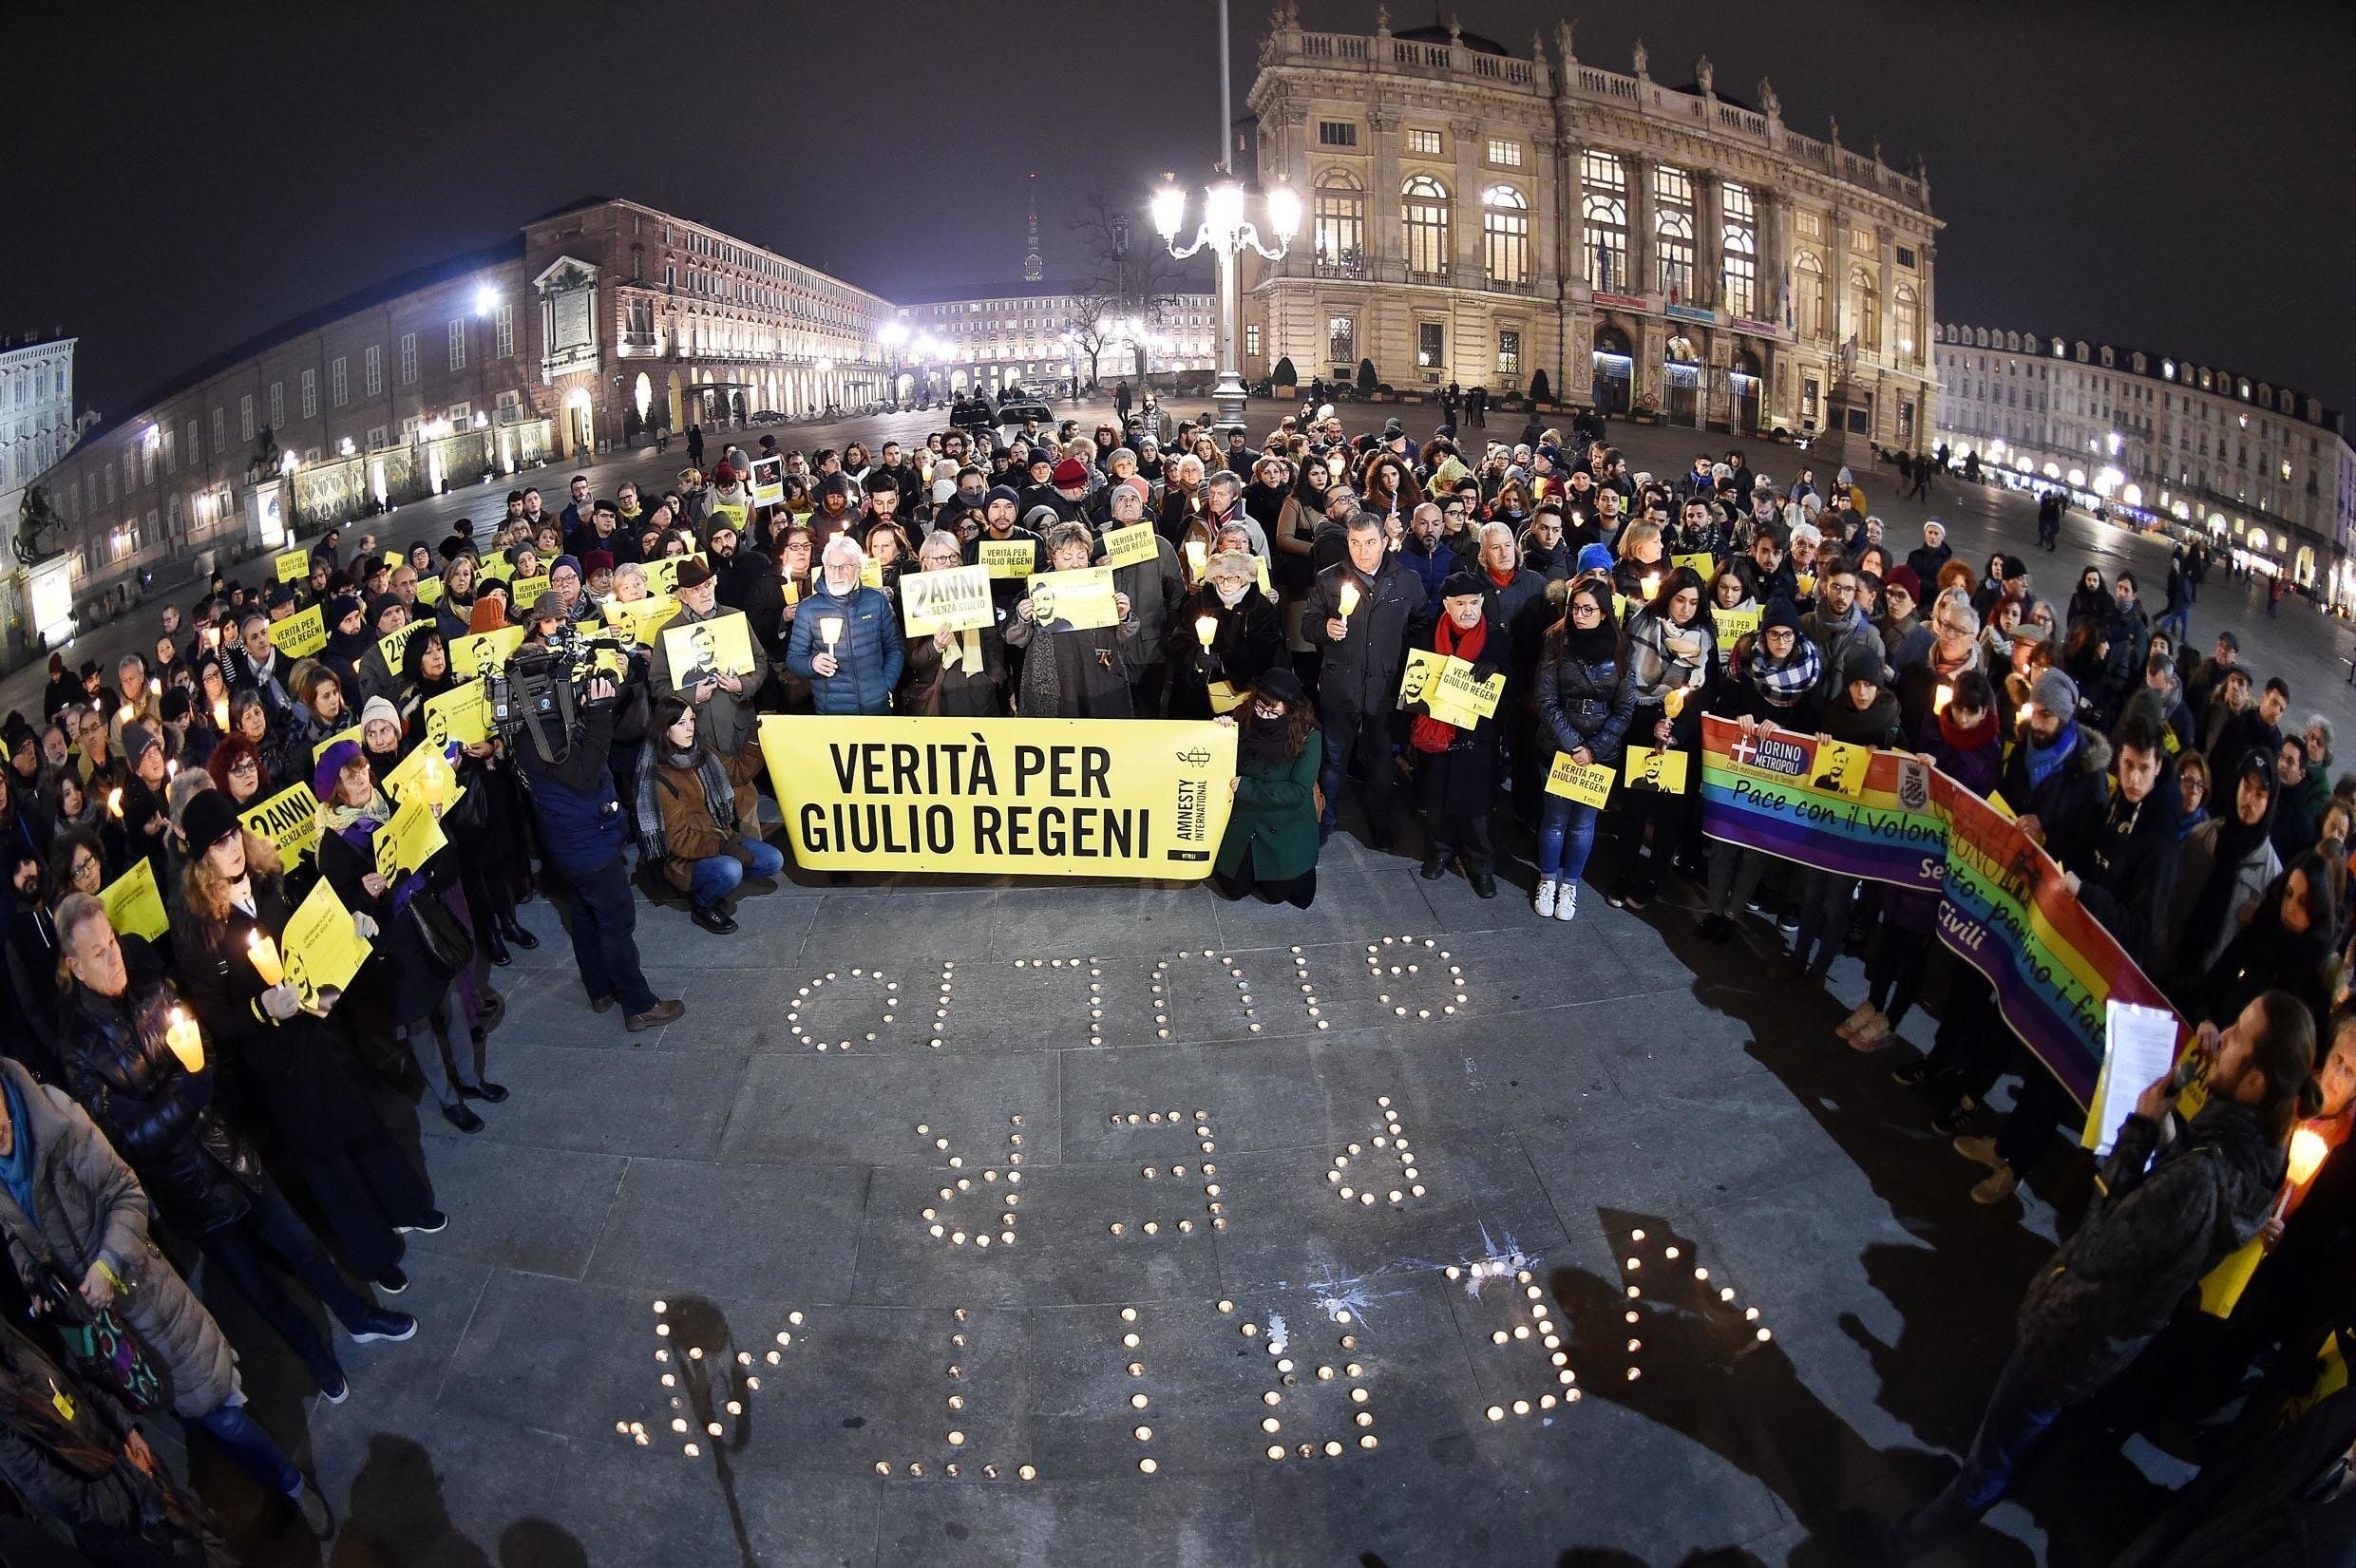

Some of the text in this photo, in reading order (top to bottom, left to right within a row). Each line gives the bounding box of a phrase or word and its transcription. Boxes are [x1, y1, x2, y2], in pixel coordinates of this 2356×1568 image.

[1109, 544, 1130, 557] GIULIO
[1131, 539, 1154, 551] REGENI
[1111, 530, 1148, 547] VERITÀ PER
[981, 557, 1033, 566] GIULIO REGENI
[987, 546, 1028, 557] VERITÀ PER
[515, 591, 534, 600] GIULIO
[518, 581, 547, 594] VERITÀ PER
[931, 599, 986, 615] SENZA GIULIO
[276, 617, 315, 641] VERITÀ PER
[1713, 617, 1750, 629] ERITÀ PER
[276, 624, 322, 652] IULIO REGENI
[1443, 674, 1498, 703] GIULIO REGENI
[1480, 680, 1495, 691] ER
[1758, 739, 1801, 762] TORINO
[829, 732, 1112, 799] VERITÀ PER
[1561, 762, 1605, 784] VERITÀ PER
[1755, 753, 1799, 775] METROPOLI
[1551, 770, 1607, 795] GIULIO REGENI
[1176, 779, 1194, 841] AMNESTY
[1194, 780, 1207, 841] INTERNATIONAL
[1732, 779, 1786, 812] Pace
[1795, 803, 1835, 825] con
[1845, 806, 1858, 834] il
[280, 829, 301, 848] SENZA
[800, 803, 1150, 859] GIULIO REGENI
[789, 935, 1469, 1052] GIULIO
[914, 1092, 1428, 1248] PER
